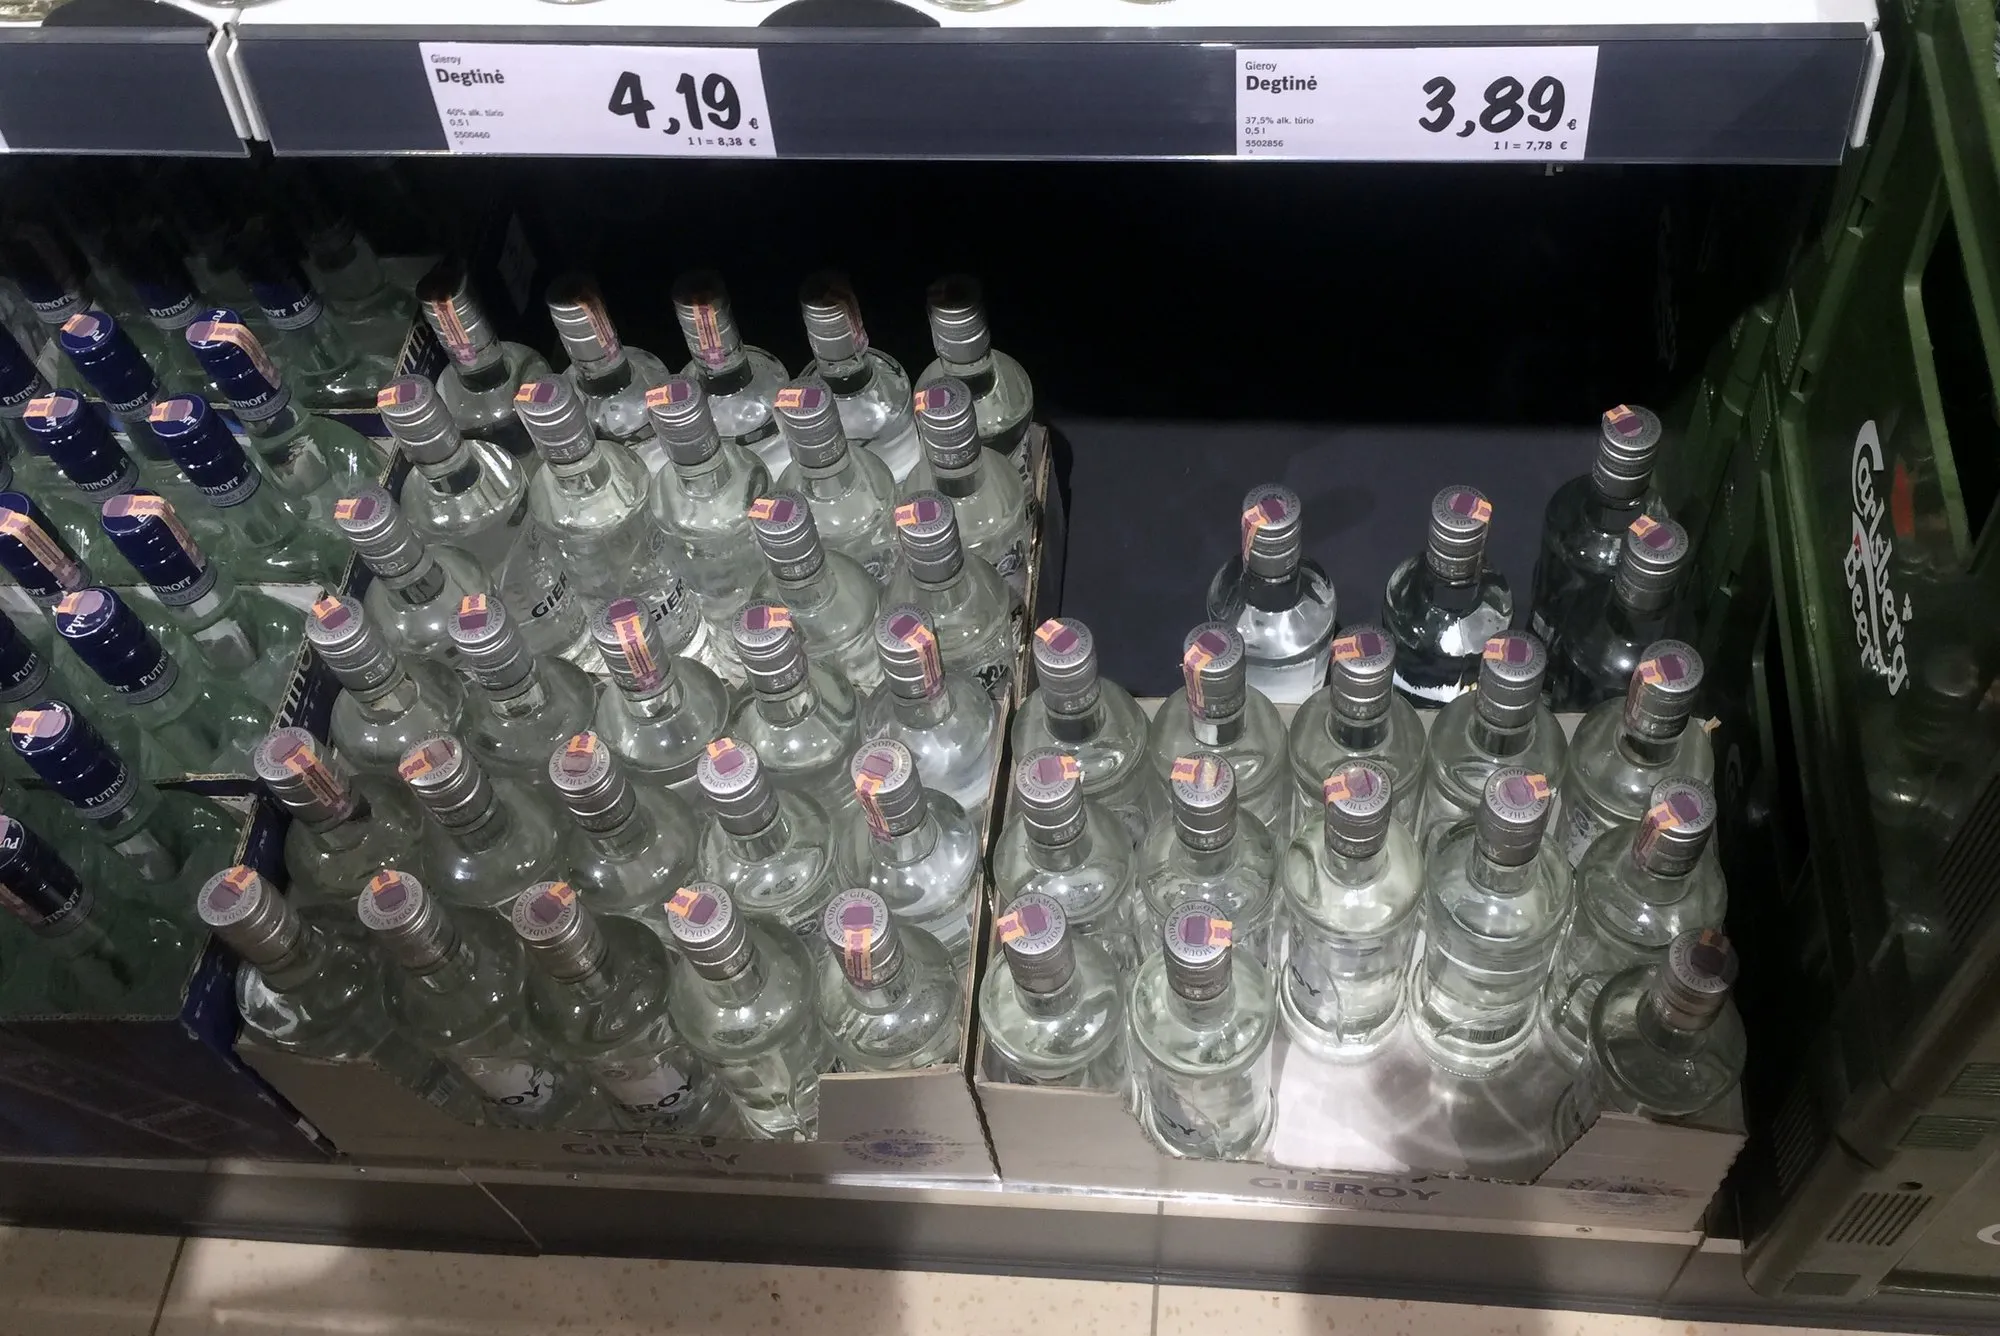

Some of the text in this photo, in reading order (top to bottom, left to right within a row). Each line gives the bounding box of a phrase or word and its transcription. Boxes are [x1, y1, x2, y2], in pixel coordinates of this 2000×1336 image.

[1245, 61, 1277, 72] Gieroy
[435, 68, 505, 87] Degtinė
[1246, 75, 1318, 94] Degtinė
[608, 71, 741, 135] 4,19
[1419, 75, 1565, 138] 3,89
[1245, 116, 1274, 124] 37,5%
[1276, 116, 1292, 124] alk.
[718, 137, 742, 147] 8,38
[1245, 139, 1284, 147] 5502856
[1526, 141, 1553, 151] 7,78
[1852, 420, 1912, 696] Carlsberg
[1249, 1177, 1441, 1202] GIEROY
